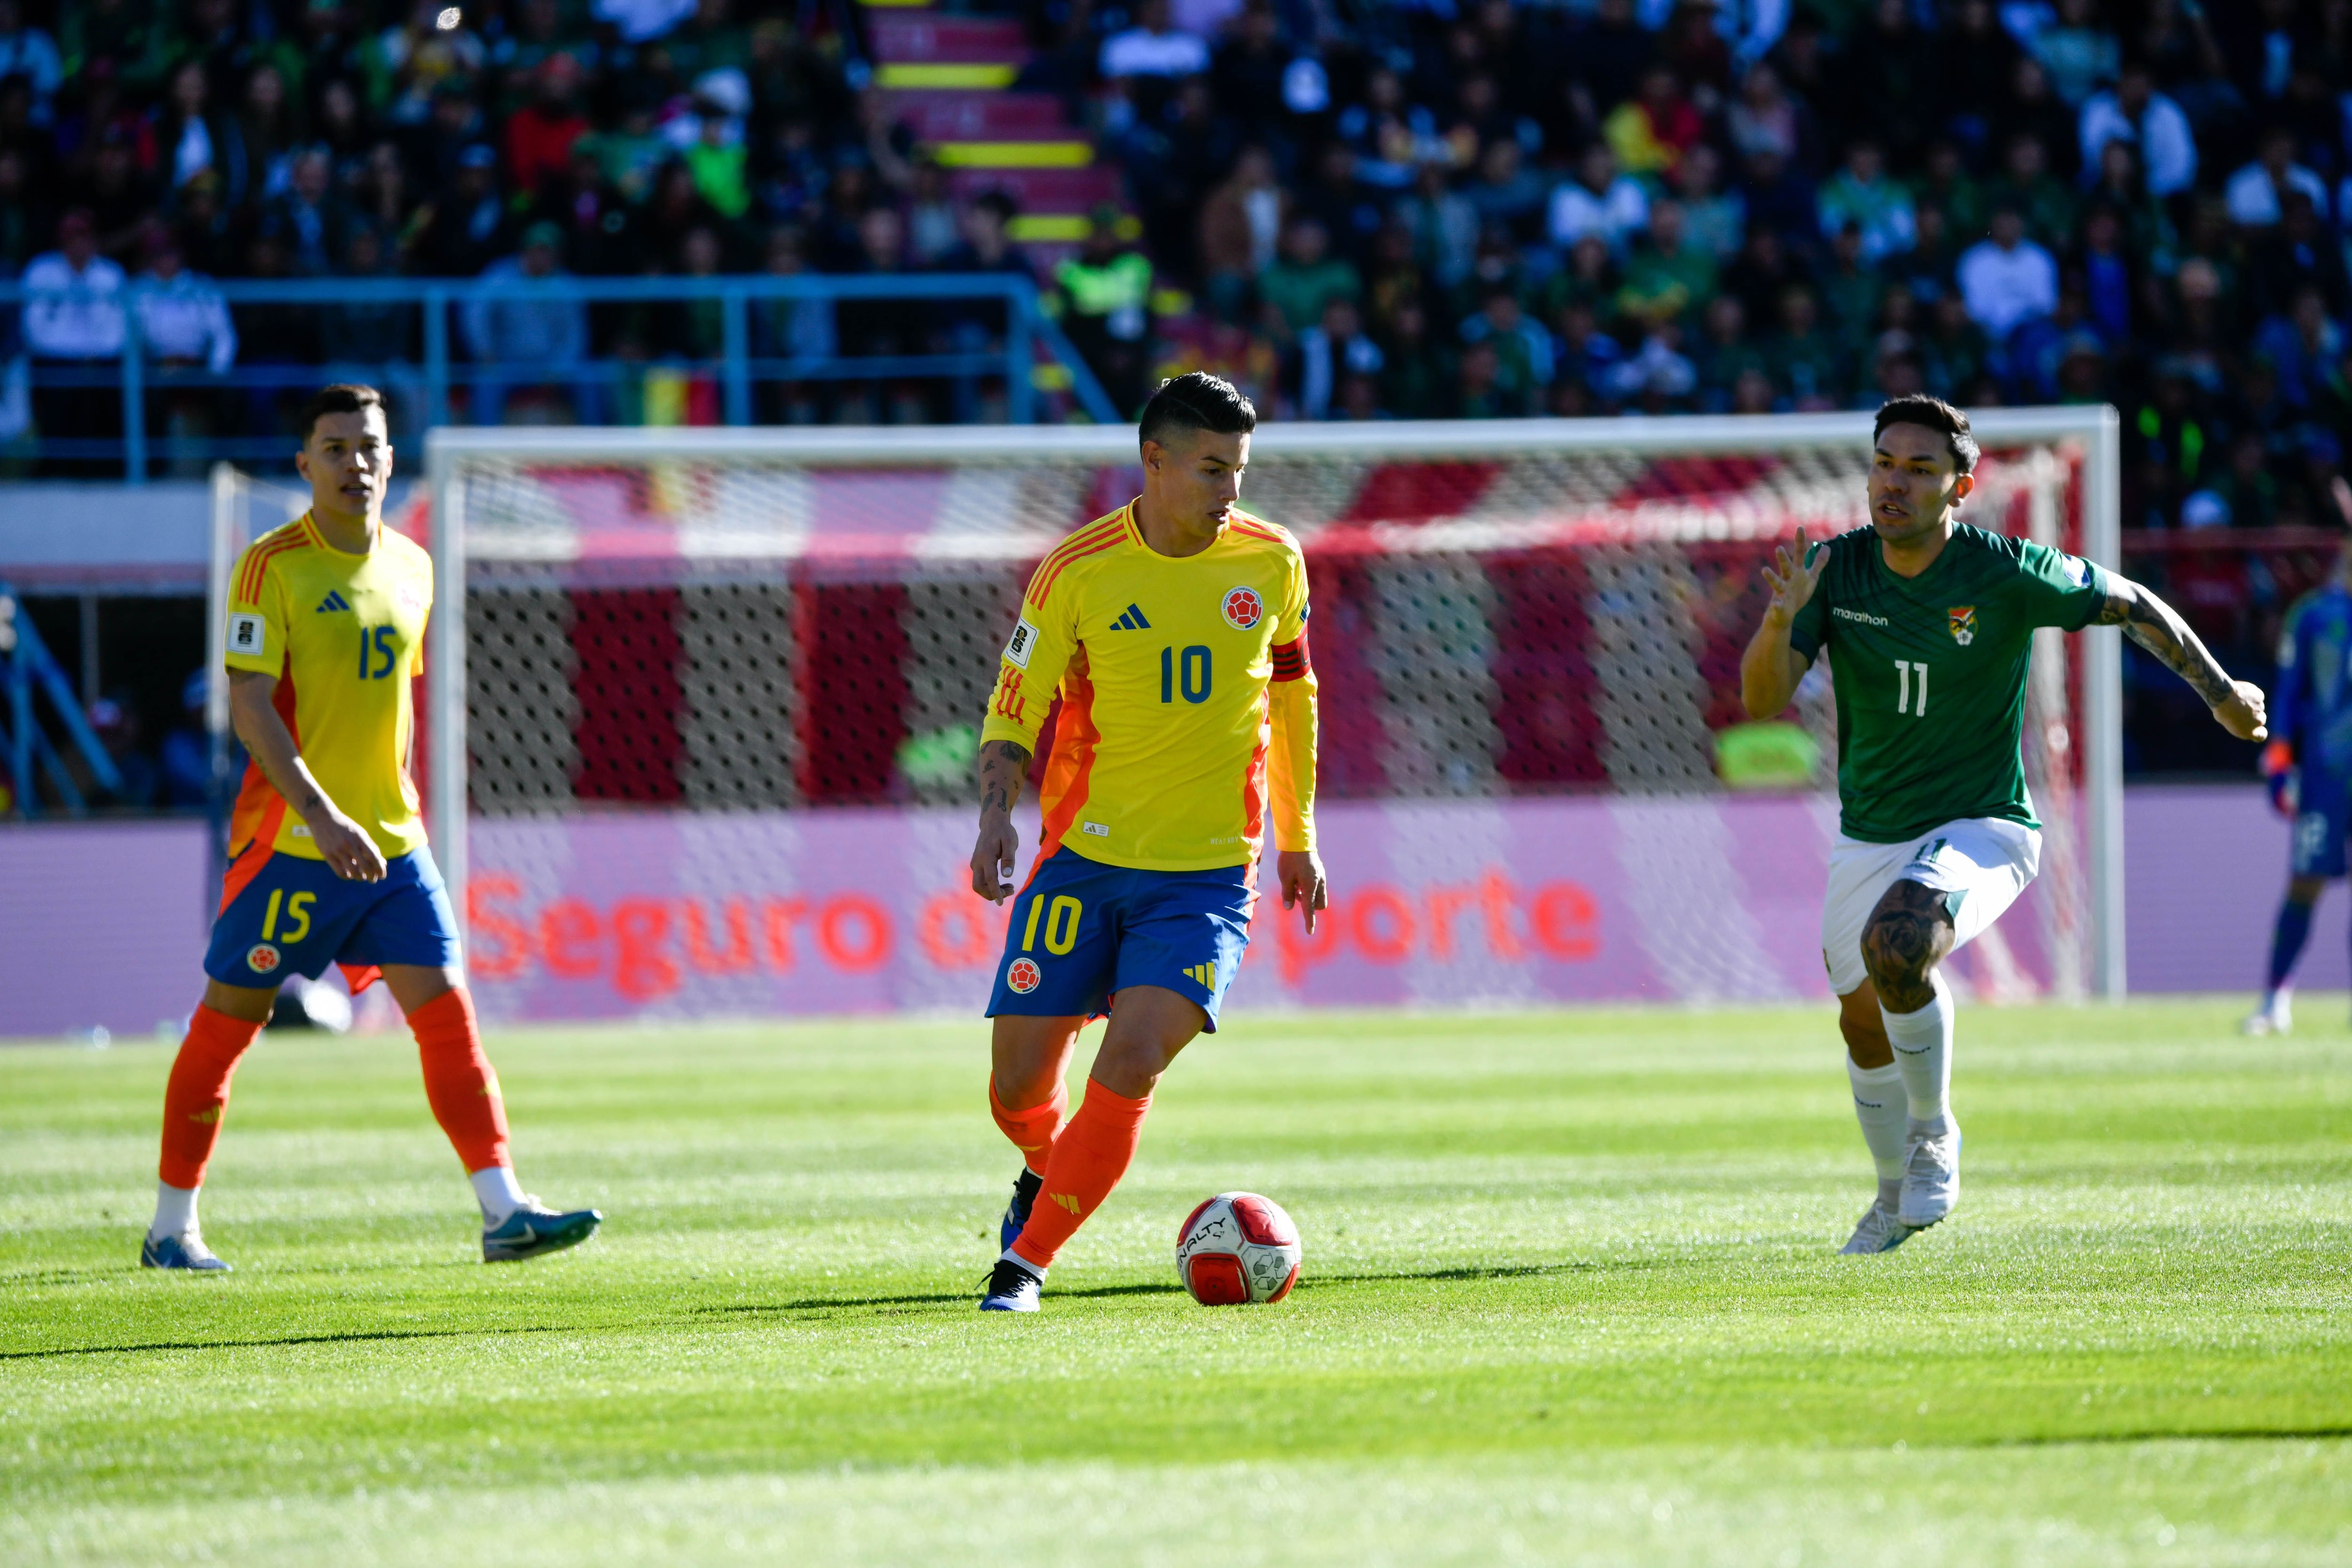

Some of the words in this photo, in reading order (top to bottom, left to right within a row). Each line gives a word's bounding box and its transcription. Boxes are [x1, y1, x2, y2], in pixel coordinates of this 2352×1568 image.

[1833, 606, 1888, 627] marathon
[359, 626, 396, 680] 15
[1161, 645, 1212, 704] 10
[1894, 659, 1928, 717] 11
[1915, 838, 1947, 864] 11
[262, 888, 317, 944] 15
[467, 871, 896, 1003] Seguro
[1022, 894, 1082, 955] 10
